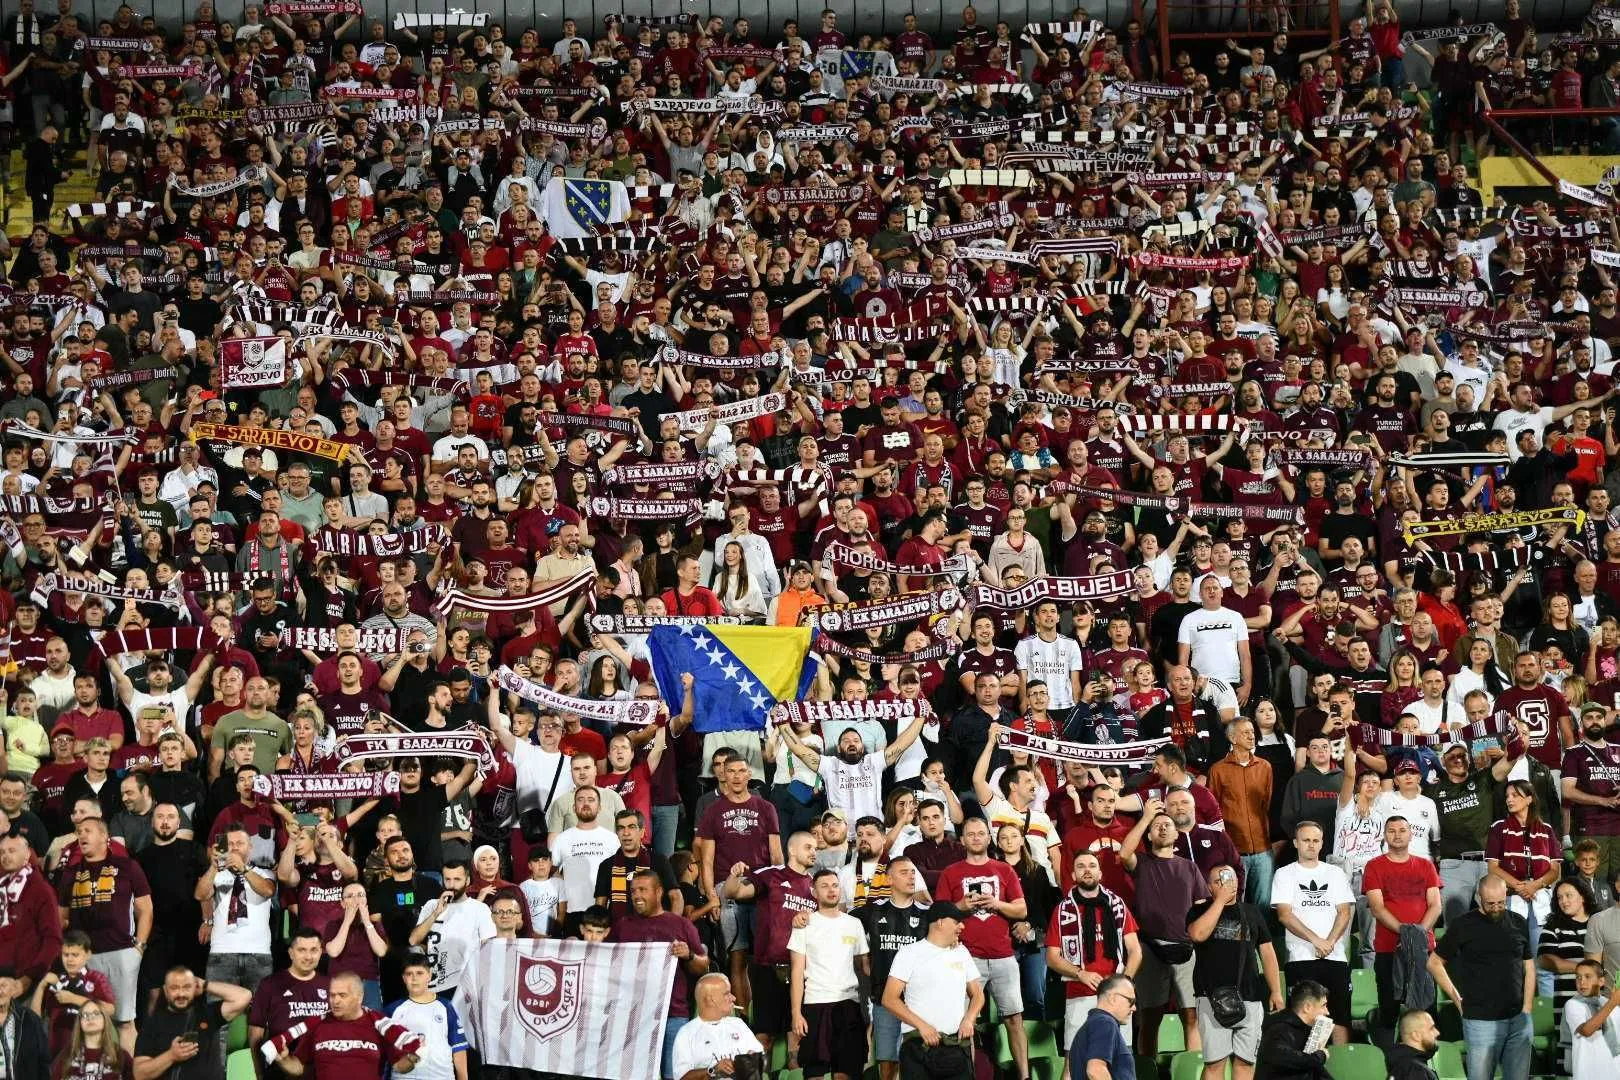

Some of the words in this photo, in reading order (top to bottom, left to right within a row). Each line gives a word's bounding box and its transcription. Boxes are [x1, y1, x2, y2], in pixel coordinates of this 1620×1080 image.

[654, 97, 711, 110] SARAJEVO
[334, 327, 385, 340] SARAJEVO
[702, 355, 754, 366] SARAJEVO
[1185, 382, 1230, 393] SARAJEVO
[1306, 452, 1362, 463] SARAJEVO
[643, 465, 696, 477] SARAJEVO
[140, 510, 162, 518] VIJEK
[636, 503, 688, 514] SARAJEVO
[979, 572, 1131, 606] BORDO-BIJELI
[871, 601, 930, 621] SARAJEVO
[1034, 667, 1065, 675] AIRLINES
[833, 700, 914, 720] SARAJEVO
[366, 740, 386, 751] FK
[402, 739, 474, 750] SARAJEVO
[1027, 736, 1046, 748] FK
[1060, 744, 1129, 759] SARAJEVO
[305, 777, 373, 791] SARAJEVO
[840, 775, 871, 783] TURKISH
[840, 781, 873, 789] AIRLINES
[1442, 792, 1477, 807] TURKISH
[1443, 799, 1480, 814] AIRLINES
[444, 803, 471, 831] 16
[308, 886, 342, 895] TURKISH
[783, 893, 818, 909] TURKISH
[1301, 899, 1331, 907] adidas
[879, 934, 917, 944] TURKISH
[288, 1001, 328, 1010] TURKISH
